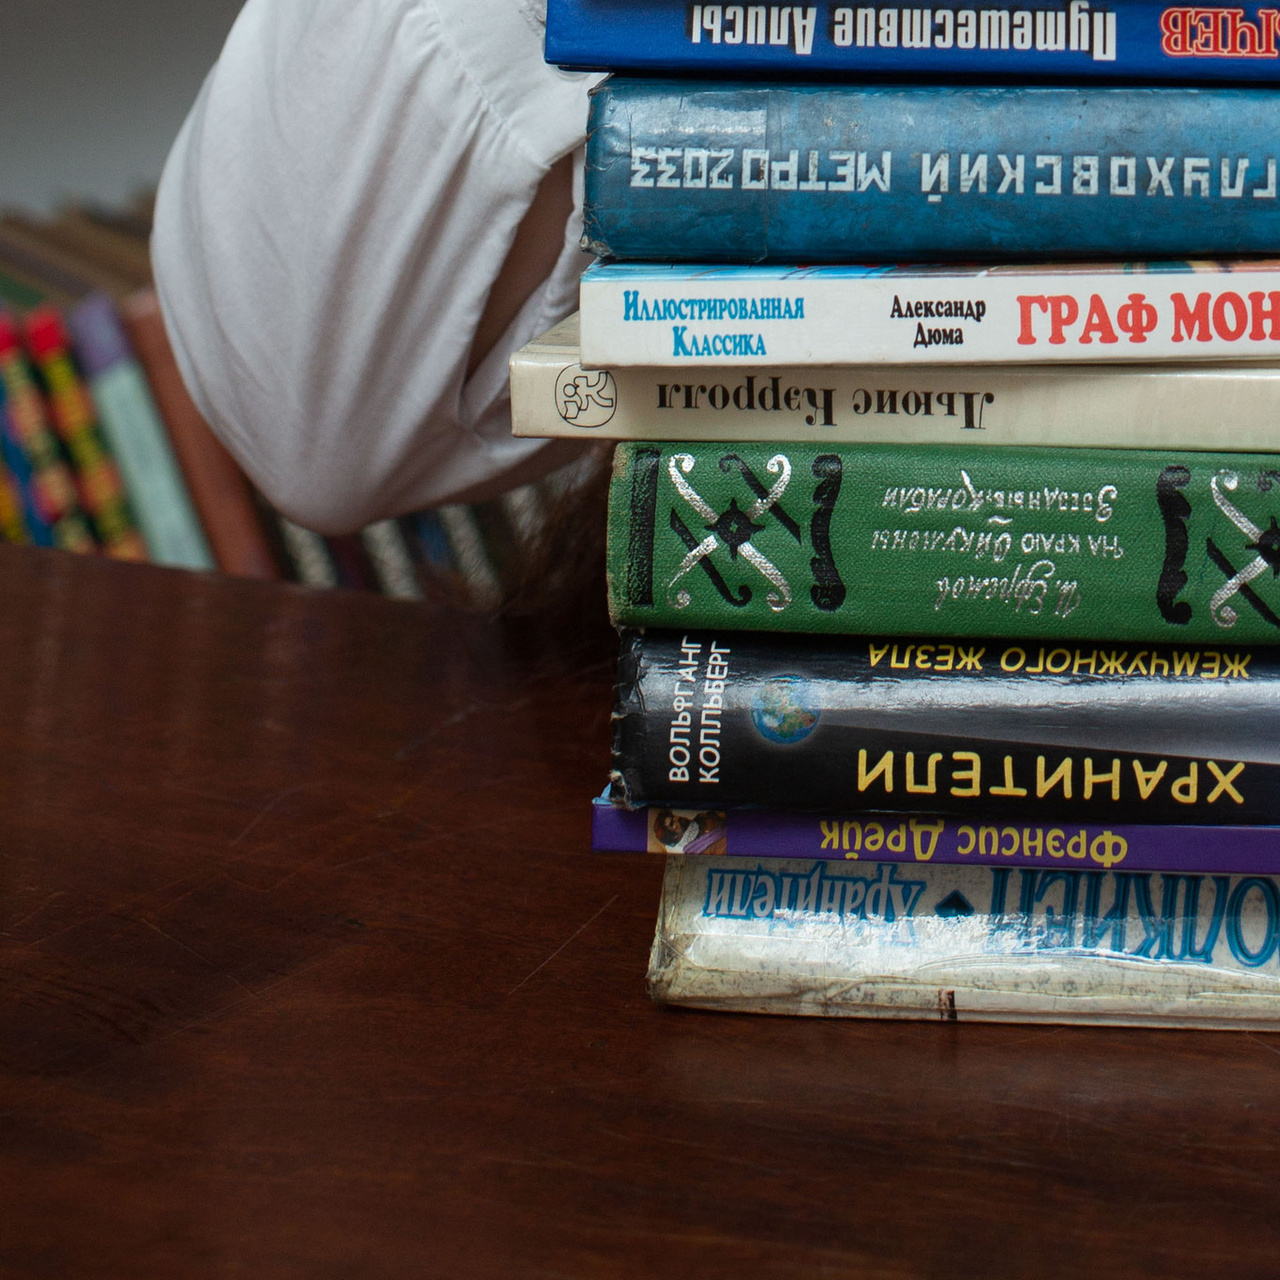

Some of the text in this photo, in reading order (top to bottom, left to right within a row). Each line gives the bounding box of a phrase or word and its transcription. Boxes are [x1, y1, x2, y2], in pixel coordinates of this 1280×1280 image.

[691, 0, 1118, 61] Путешествие Алисы
[920, 152, 1278, 203] ГЛУХОВСКИЙ
[890, 294, 987, 323] Александр
[1016, 293, 1159, 345] ГРАФ
[913, 322, 964, 349] Дюма
[656, 375, 995, 430] Льюис Кэрролл
[1021, 532, 1081, 554] КРАЮ
[934, 559, 1056, 615] Ефремов
[869, 642, 1252, 680] ЖЕМЧУЖНОГО ЖЕЗЛА
[668, 635, 702, 782] ВОЛЬФГАНГ
[699, 640, 731, 783] КОЛЛЬБЕРГ
[857, 748, 1246, 804] ХРАНИТЕЛИ
[819, 818, 1128, 868] Фрэнсис Дрейк
